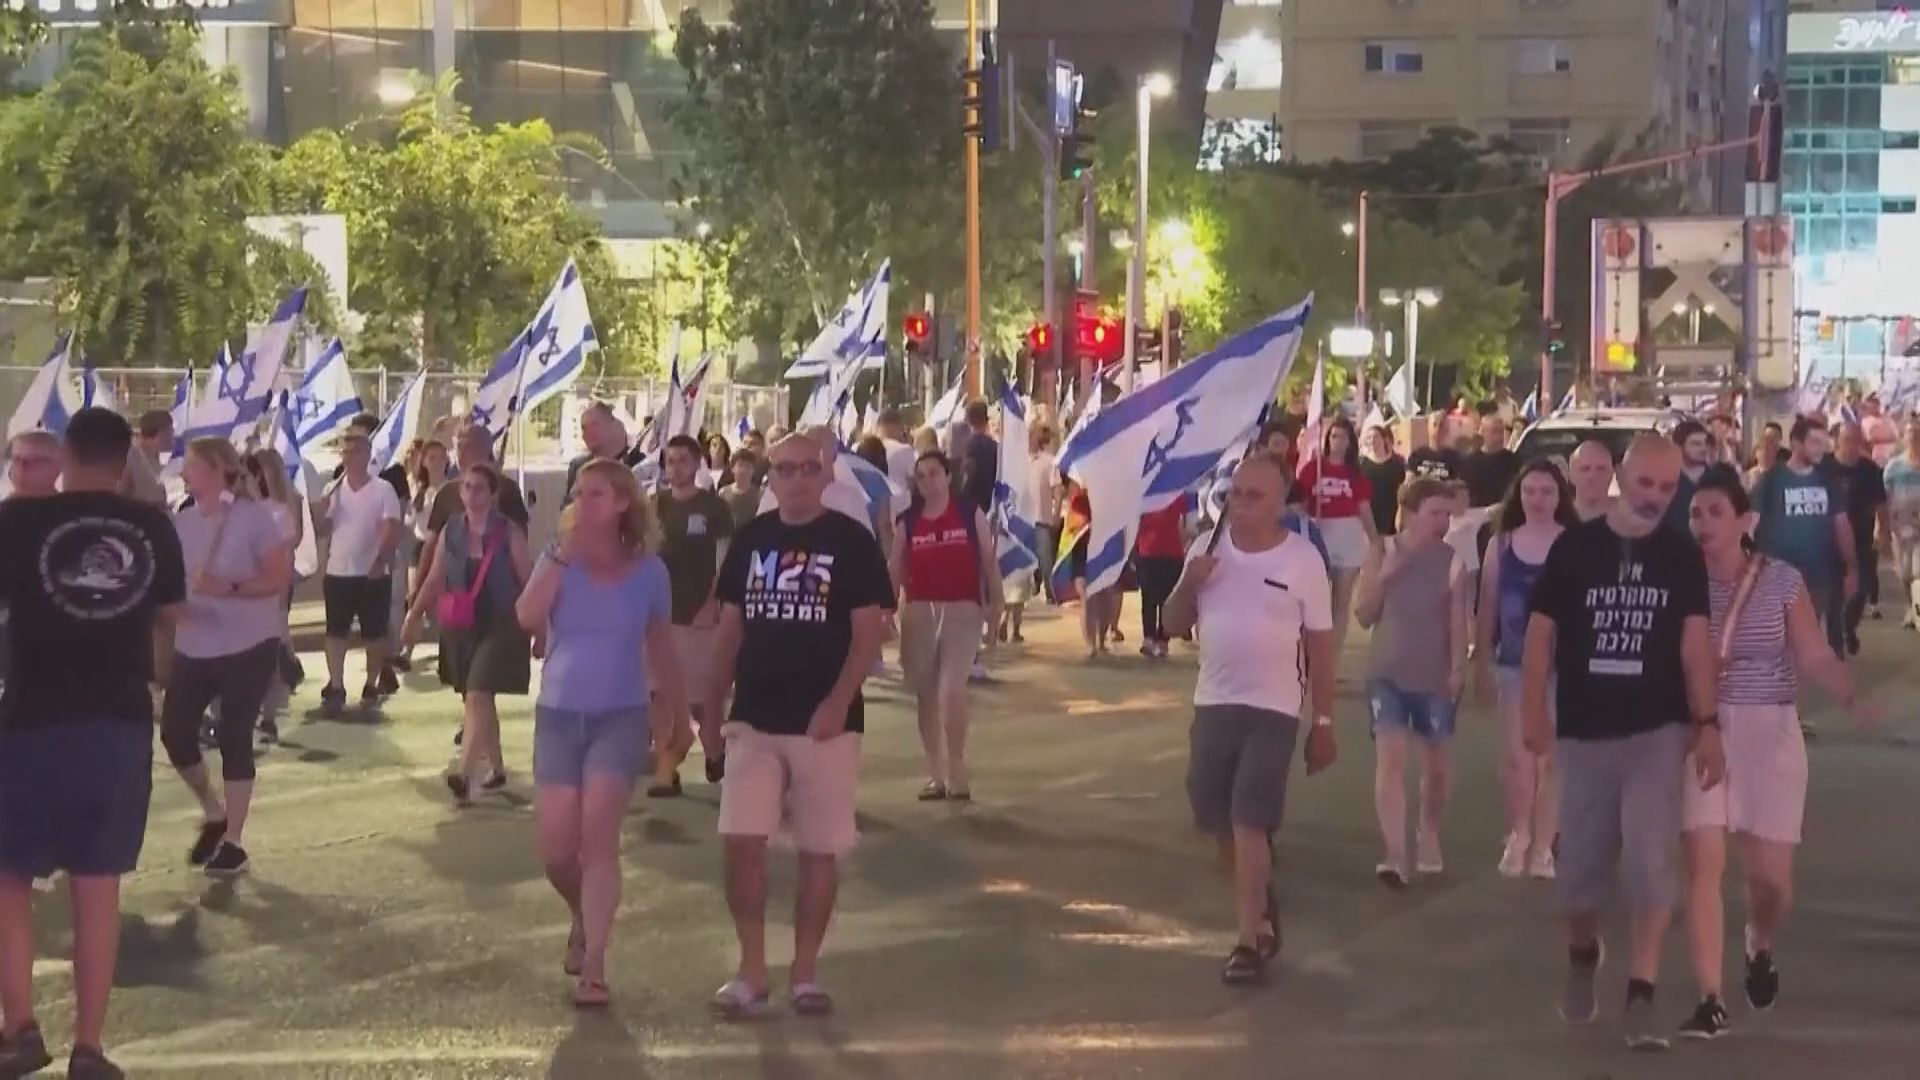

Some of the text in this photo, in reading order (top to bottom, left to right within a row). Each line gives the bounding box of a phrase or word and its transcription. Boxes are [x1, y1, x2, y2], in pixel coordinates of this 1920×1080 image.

[746, 550, 834, 594] M25
[1585, 585, 1670, 608] דמוקרטיה
[1592, 609, 1654, 630] במדינת
[1596, 631, 1643, 652] הלכה
